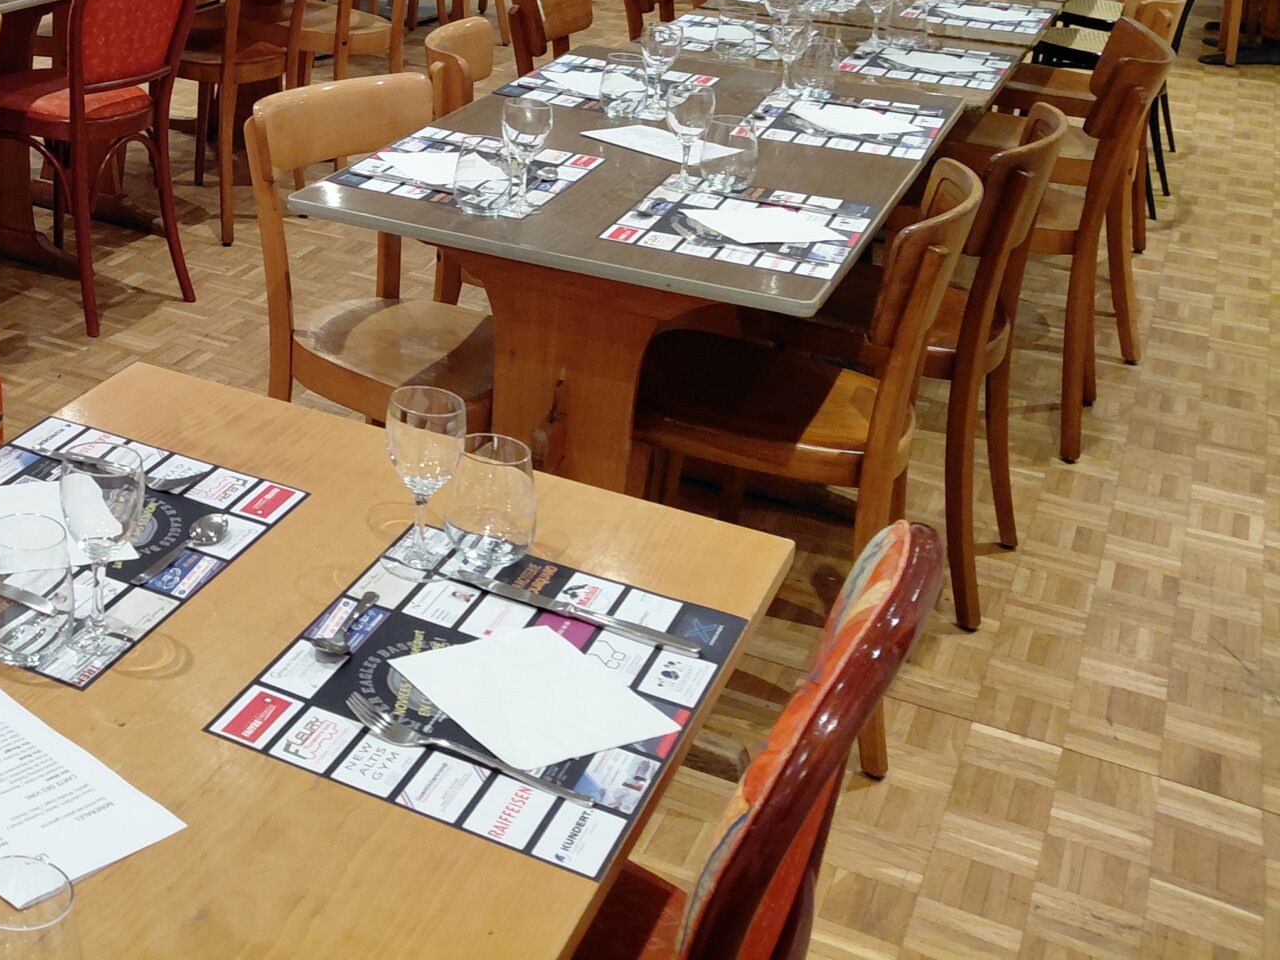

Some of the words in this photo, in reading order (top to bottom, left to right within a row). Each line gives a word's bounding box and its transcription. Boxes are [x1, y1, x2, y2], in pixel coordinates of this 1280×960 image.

[528, 565, 558, 595] OURQUARD
[282, 716, 322, 760] FLEURY
[345, 742, 372, 771] NEW
[359, 747, 386, 776] ALTIS
[372, 752, 400, 781] GYM
[486, 784, 535, 840] RAIFFEISEN
